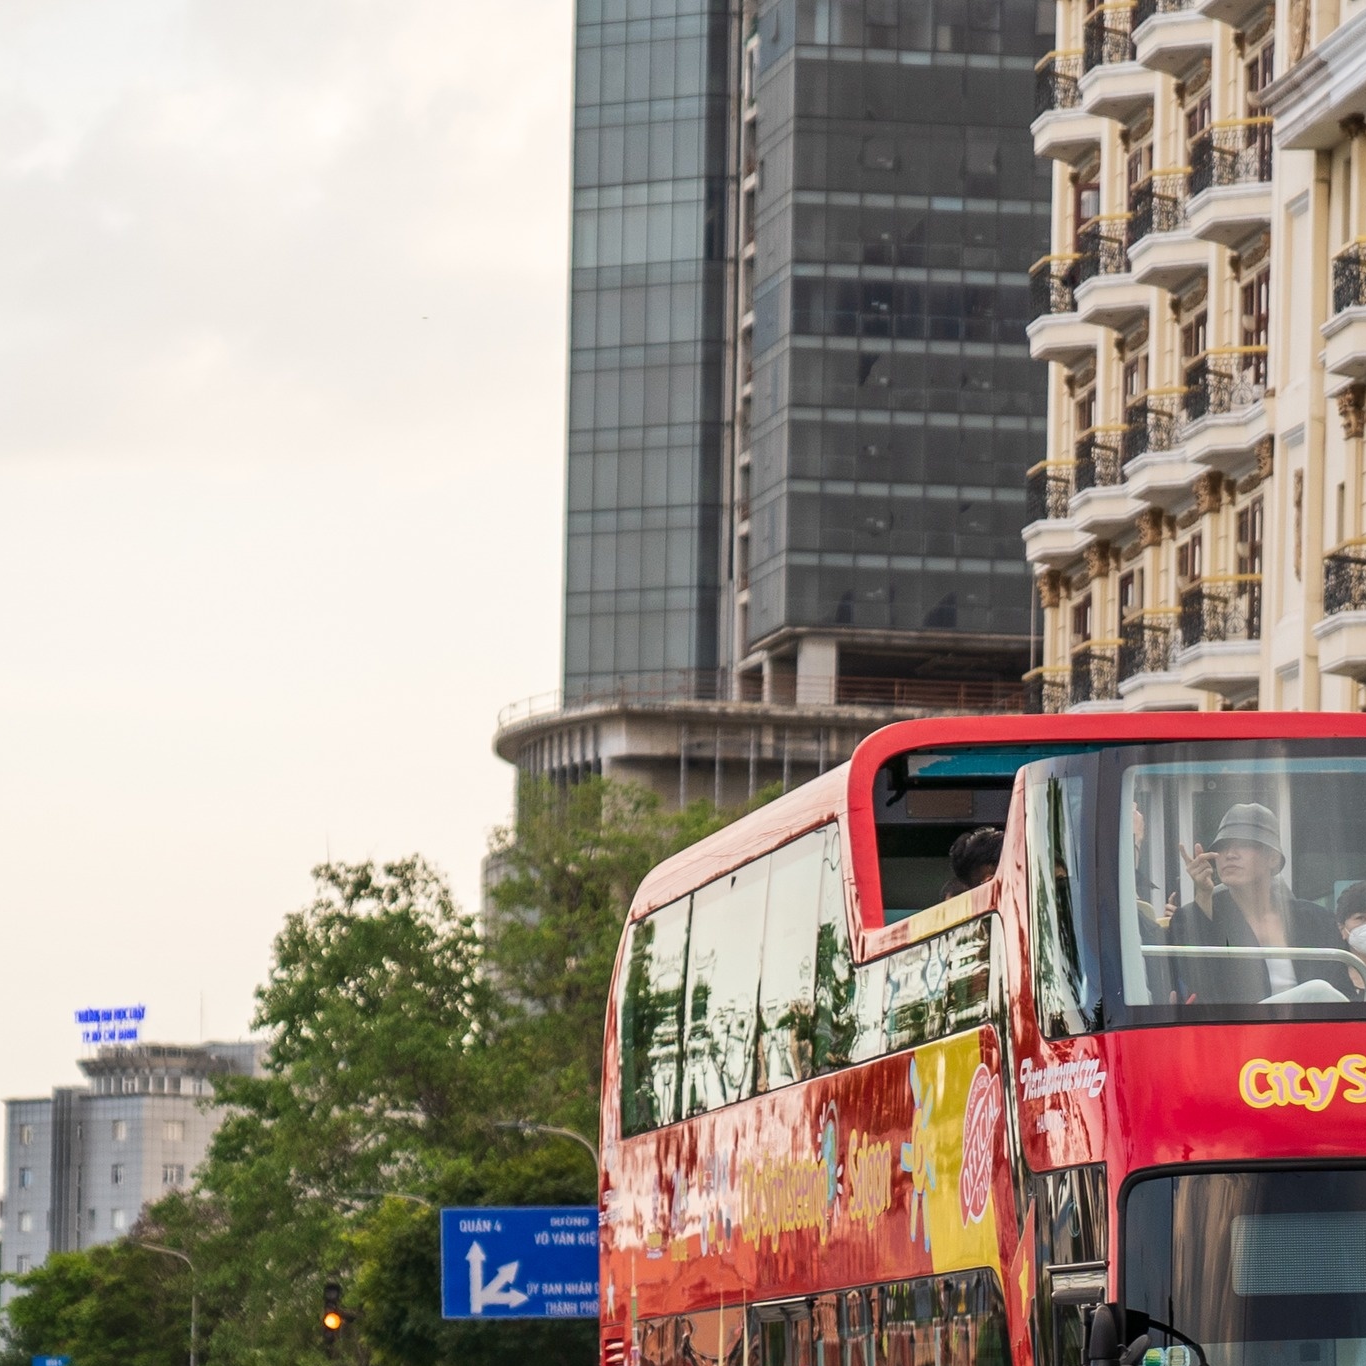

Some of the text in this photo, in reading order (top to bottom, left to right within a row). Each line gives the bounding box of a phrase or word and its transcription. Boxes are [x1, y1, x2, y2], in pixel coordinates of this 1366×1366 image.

[963, 1085, 999, 1206] OFFICIAL
[849, 1129, 891, 1230] Saigon
[494, 1220, 502, 1232] 4
[578, 1230, 598, 1246] KIỆ
[542, 1282, 562, 1295] BAN
